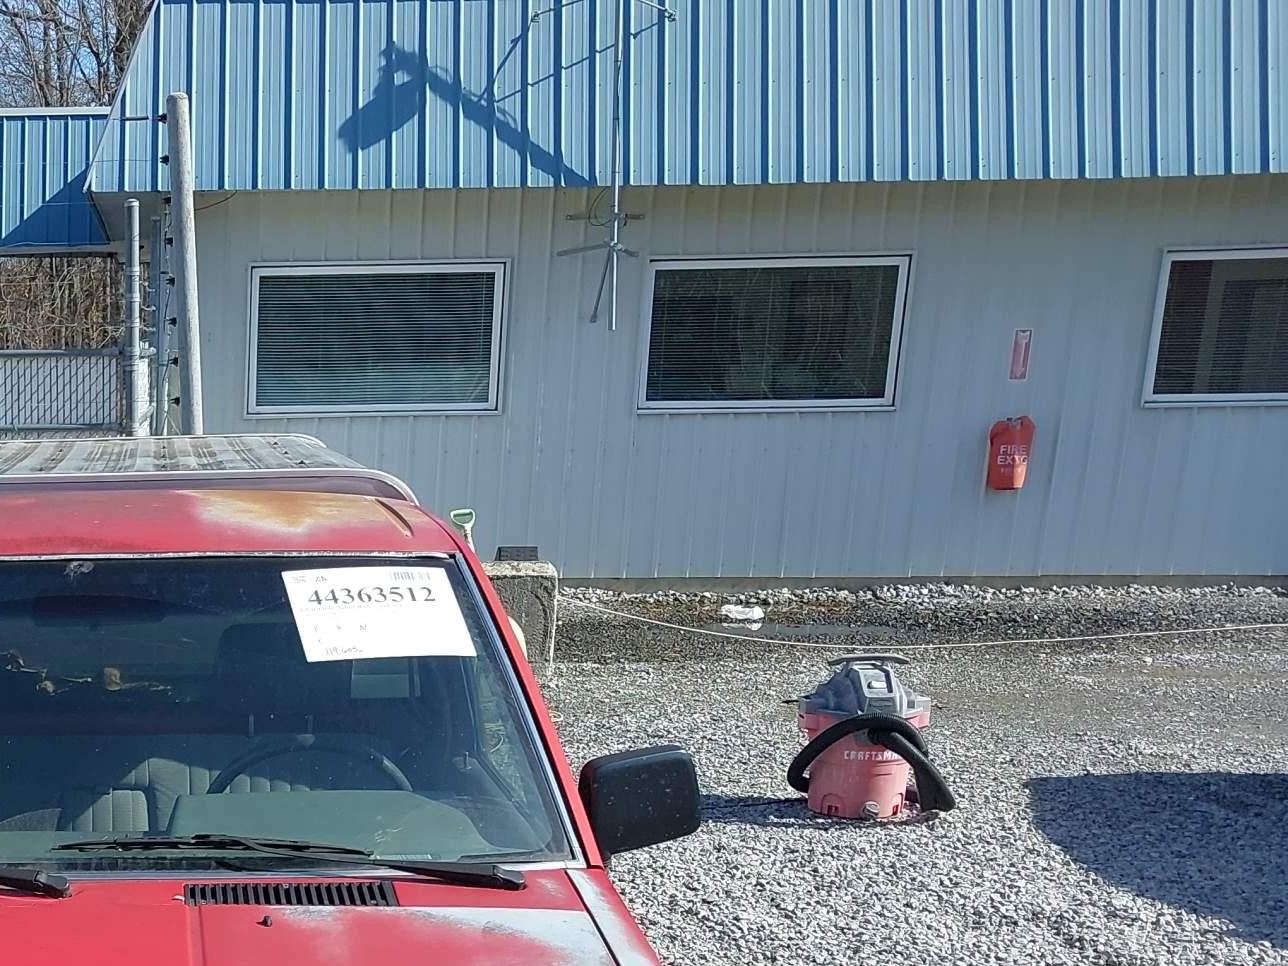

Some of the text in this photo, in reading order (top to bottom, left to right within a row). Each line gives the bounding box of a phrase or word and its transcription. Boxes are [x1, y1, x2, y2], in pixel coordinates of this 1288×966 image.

[1000, 445, 1028, 455] FIRE
[308, 586, 436, 606] 44363512
[844, 750, 903, 761] CRAFTSMA
